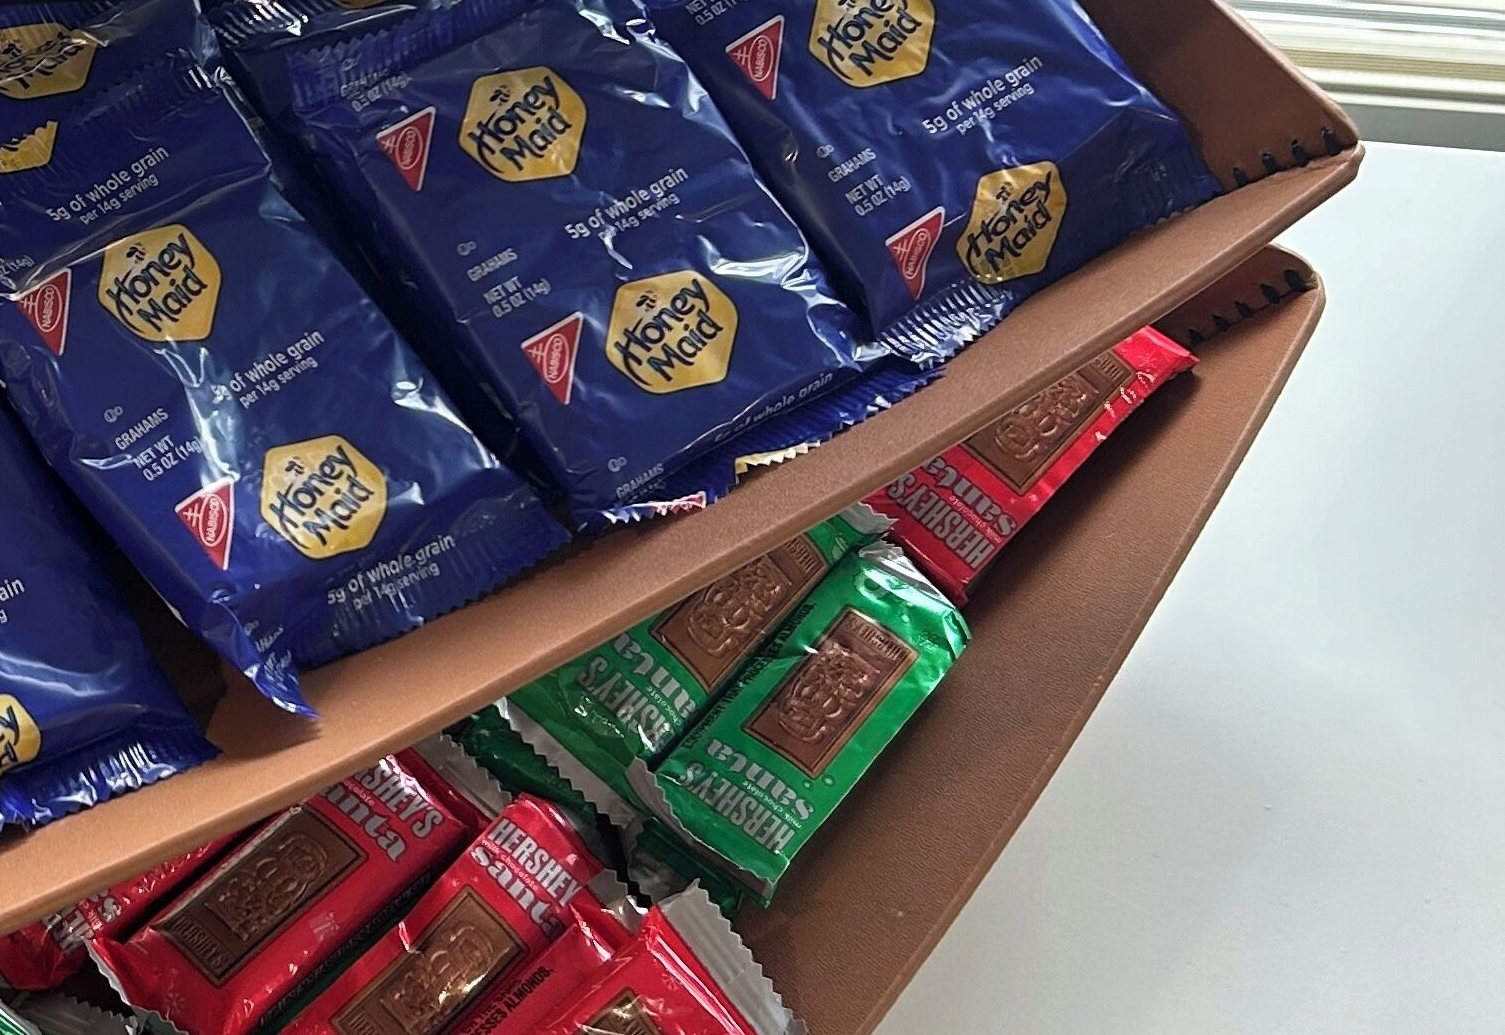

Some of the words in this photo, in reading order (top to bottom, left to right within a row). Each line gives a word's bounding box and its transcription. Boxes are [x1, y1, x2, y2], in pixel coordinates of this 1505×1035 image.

[849, 7, 923, 76] Maid
[468, 75, 561, 174] Honey
[922, 116, 948, 135] 5g
[946, 100, 966, 121] of
[961, 79, 1005, 108] whole
[1005, 54, 1044, 86] grain
[500, 105, 573, 172] Maid
[827, 147, 877, 183] GRAHAMS
[46, 206, 72, 222] 5g
[69, 193, 89, 213] of
[85, 168, 131, 202] whole
[133, 144, 170, 178] grain
[564, 218, 591, 239] 5g
[588, 204, 607, 228] of
[606, 188, 651, 219] whole
[648, 167, 690, 200] grain
[966, 170, 1053, 277] Honey
[984, 201, 1053, 273] Maid
[106, 232, 195, 335] Honey
[136, 265, 208, 333] Maid
[613, 278, 711, 386] Honey
[646, 309, 724, 383] Maid
[238, 392, 259, 410] per
[257, 379, 280, 398] 14g
[279, 354, 319, 385] serving
[114, 407, 170, 452] GRAHAMS
[133, 449, 156, 470] NET
[155, 434, 175, 454] WT
[269, 444, 358, 549] Honey
[302, 474, 374, 547] Maid
[886, 471, 996, 570] HERSHEY'S
[678, 763, 795, 854] HERSHEY'S
